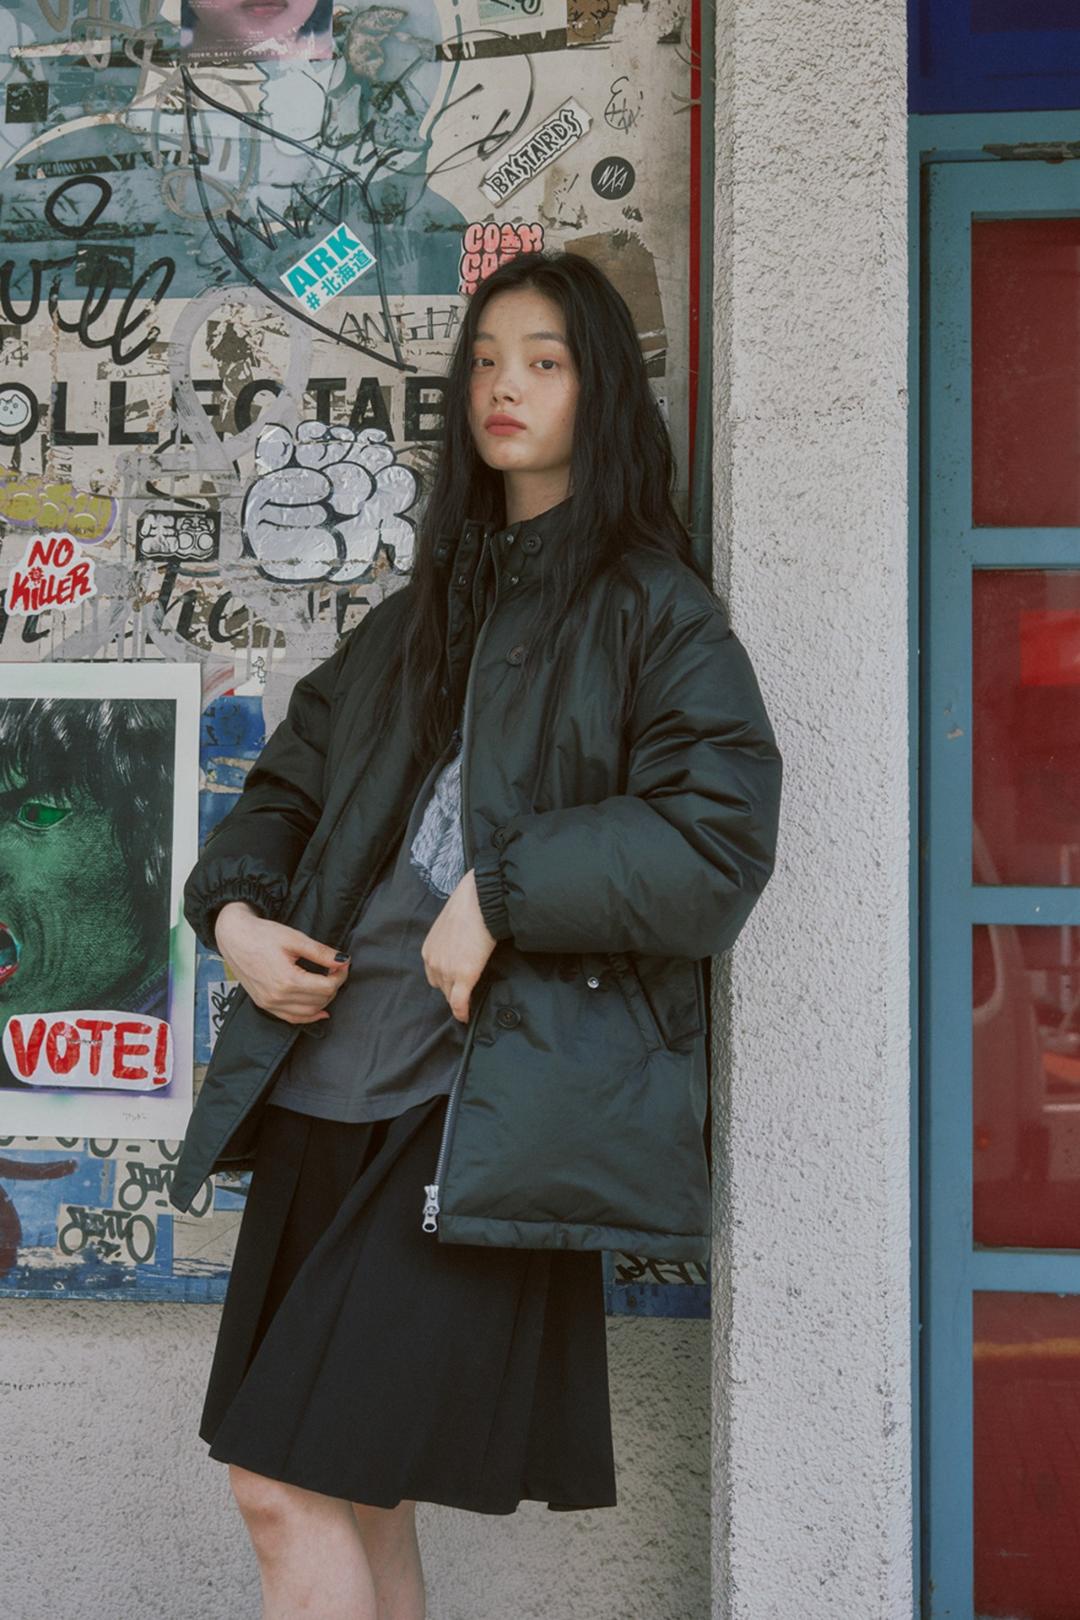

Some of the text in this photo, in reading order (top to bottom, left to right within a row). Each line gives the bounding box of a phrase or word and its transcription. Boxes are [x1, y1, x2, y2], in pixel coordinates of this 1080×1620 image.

[490, 112, 580, 196] BASTARDS
[287, 226, 360, 298] ARK
[28, 538, 74, 568] NO
[9, 1018, 168, 1085] VOTE!
